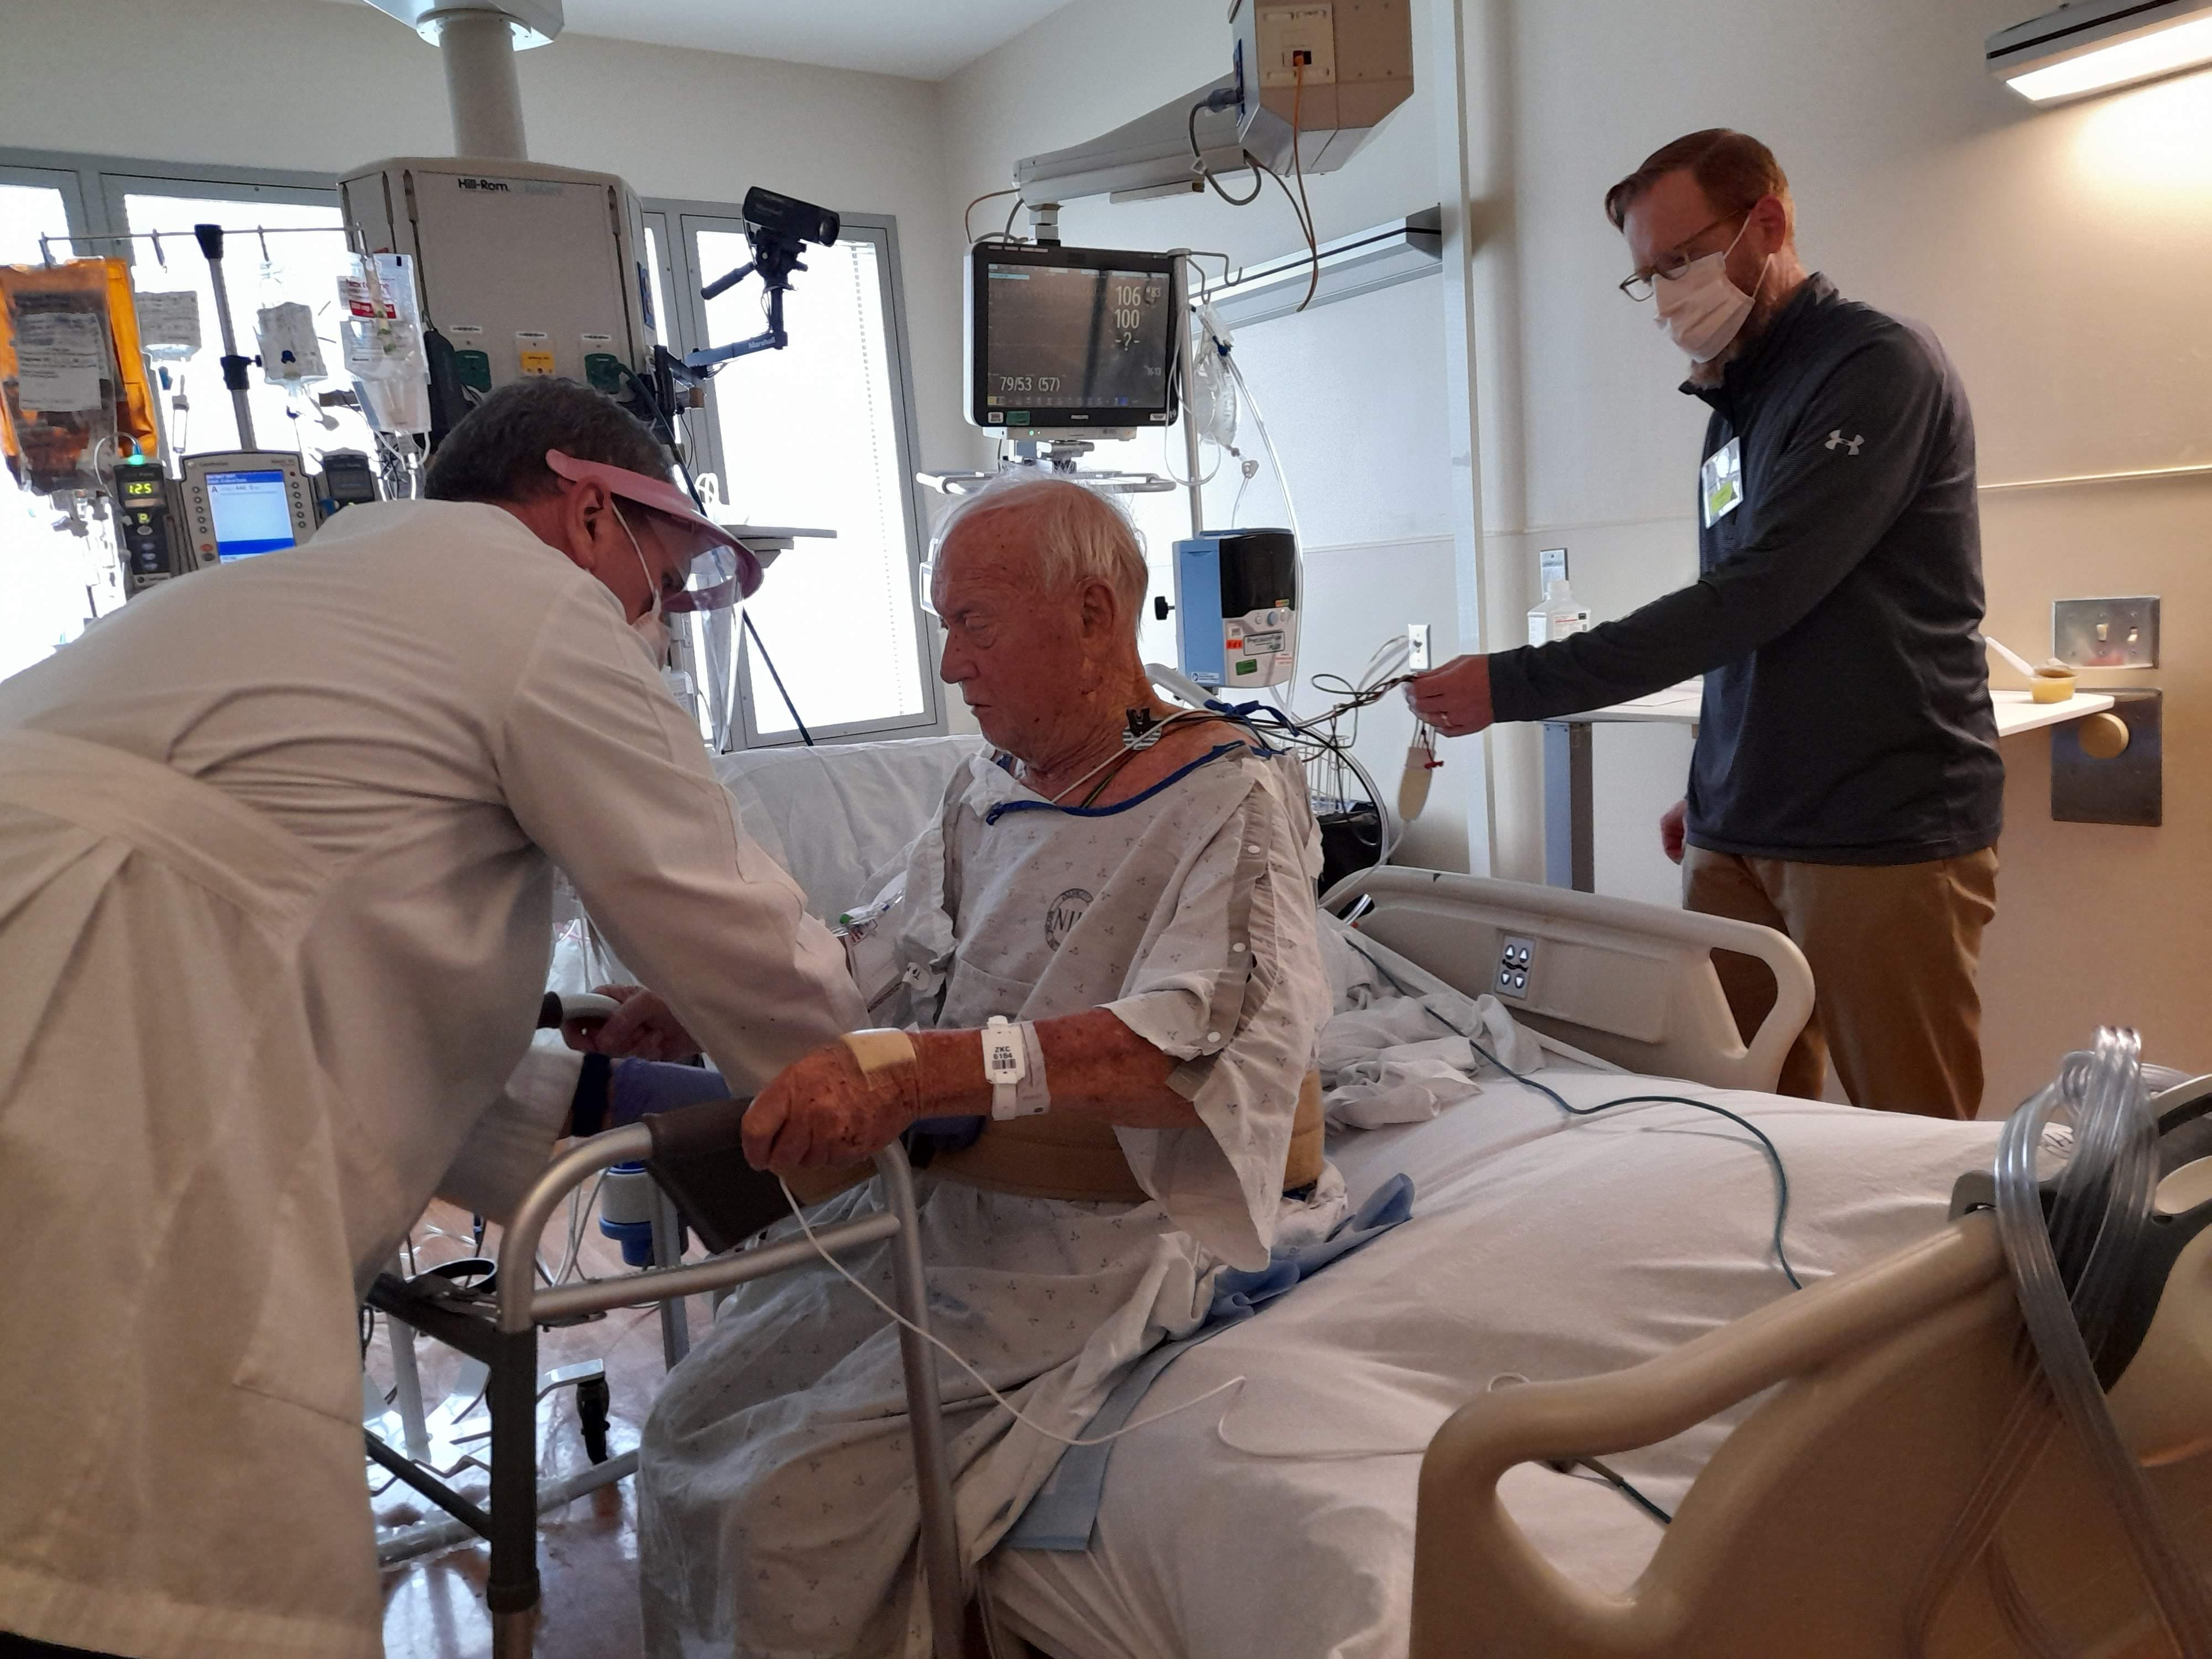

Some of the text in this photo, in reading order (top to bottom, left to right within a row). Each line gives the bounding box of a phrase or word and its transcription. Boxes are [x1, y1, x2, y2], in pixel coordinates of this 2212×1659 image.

[1116, 285, 1141, 306] 106
[1114, 309, 1140, 328] 100
[999, 377, 1060, 392] 79/53 (57)
[129, 483, 152, 494] 125
[1053, 907, 1083, 932] NI
